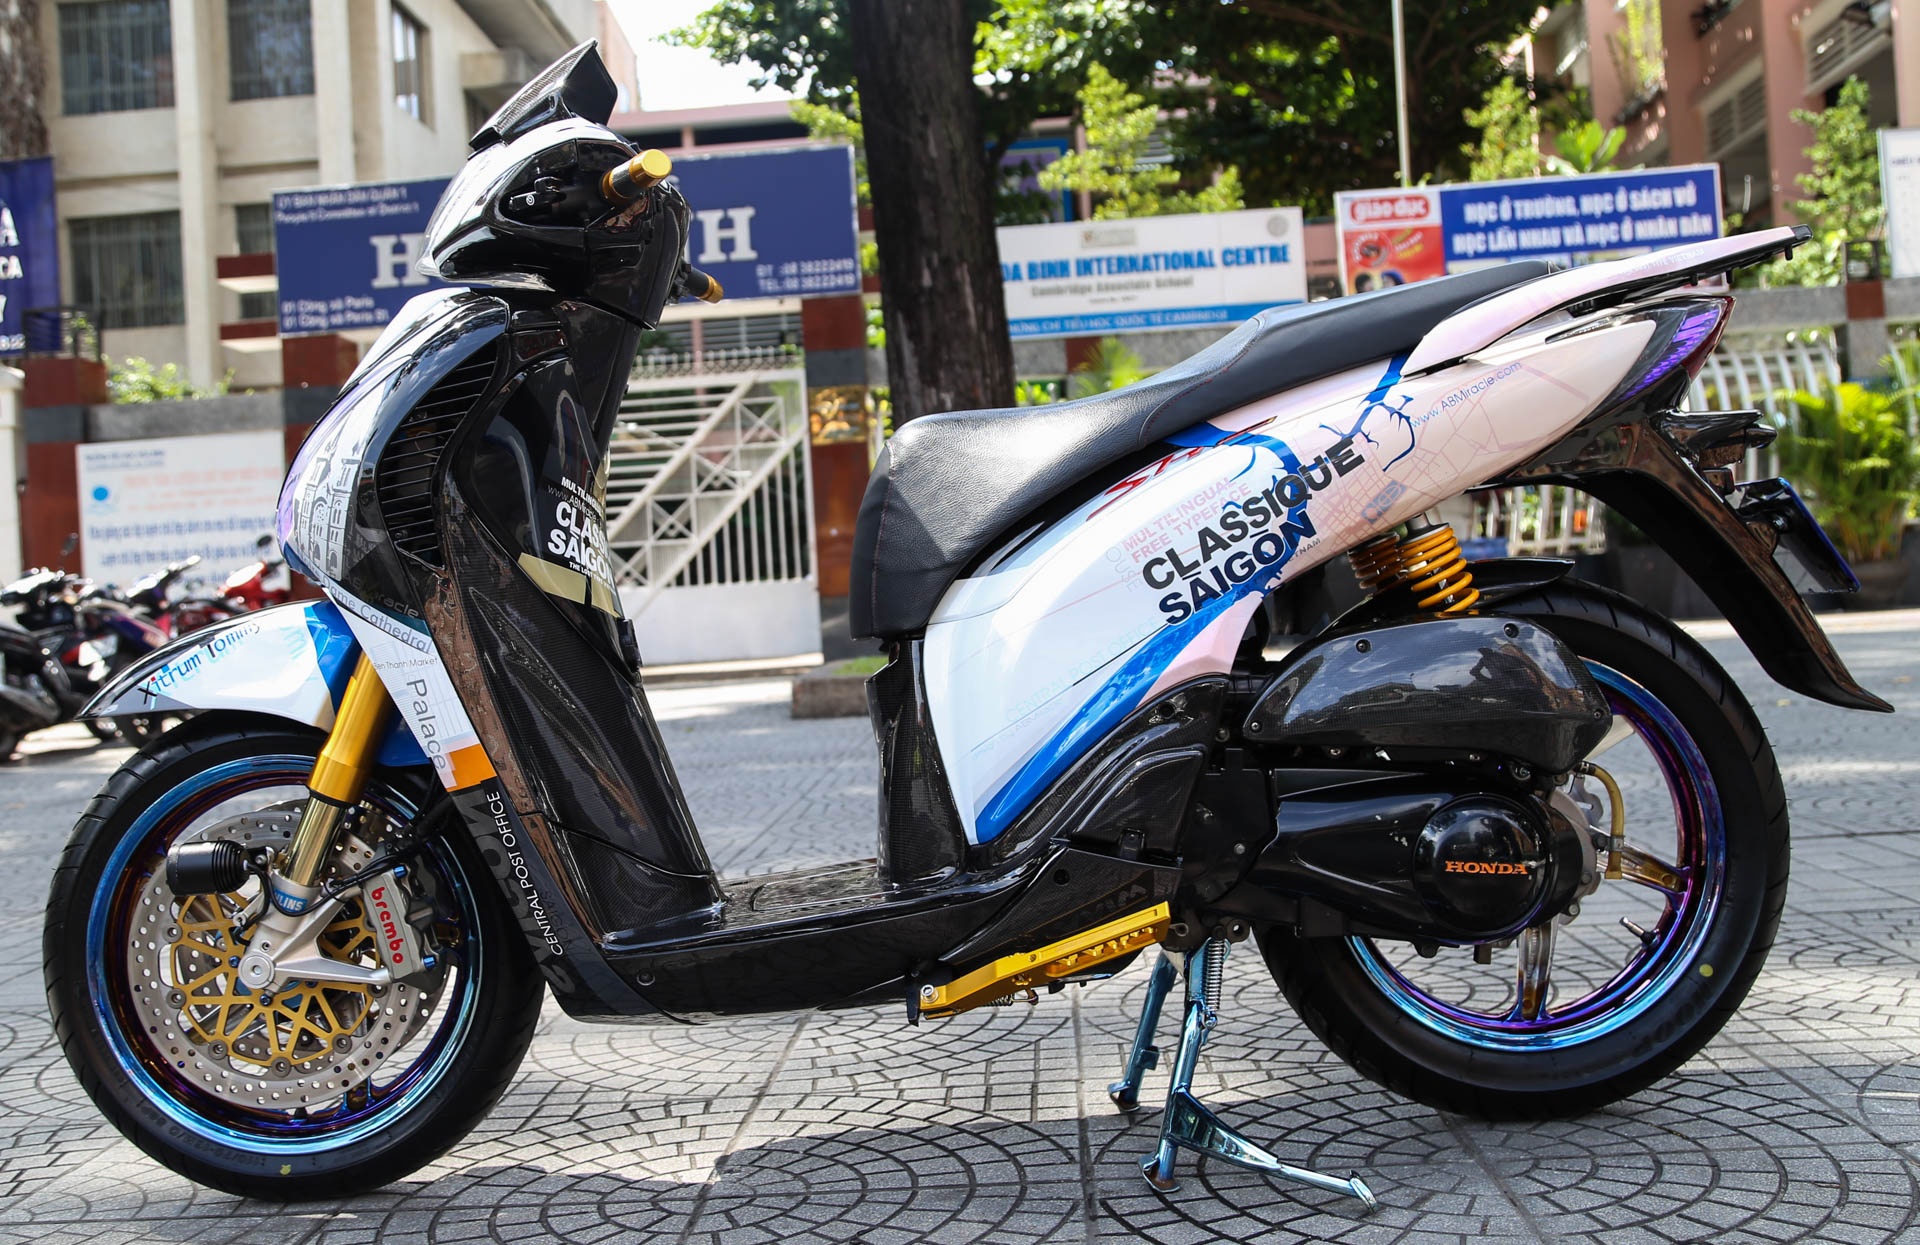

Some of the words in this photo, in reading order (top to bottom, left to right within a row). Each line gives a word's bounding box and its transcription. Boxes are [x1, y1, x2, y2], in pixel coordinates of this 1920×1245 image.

[1076, 249, 1216, 277] INTERNATIONAL
[1222, 243, 1290, 267] CENTRE
[1142, 437, 1366, 590] CLASSIQUE
[360, 604, 433, 654] Cathedral
[406, 679, 446, 770] Palace
[487, 791, 516, 848] OFFICE
[508, 852, 534, 889] POST
[1445, 860, 1528, 875] HONDA
[372, 886, 404, 964] brembo
[527, 890, 564, 956] CENTRAL
